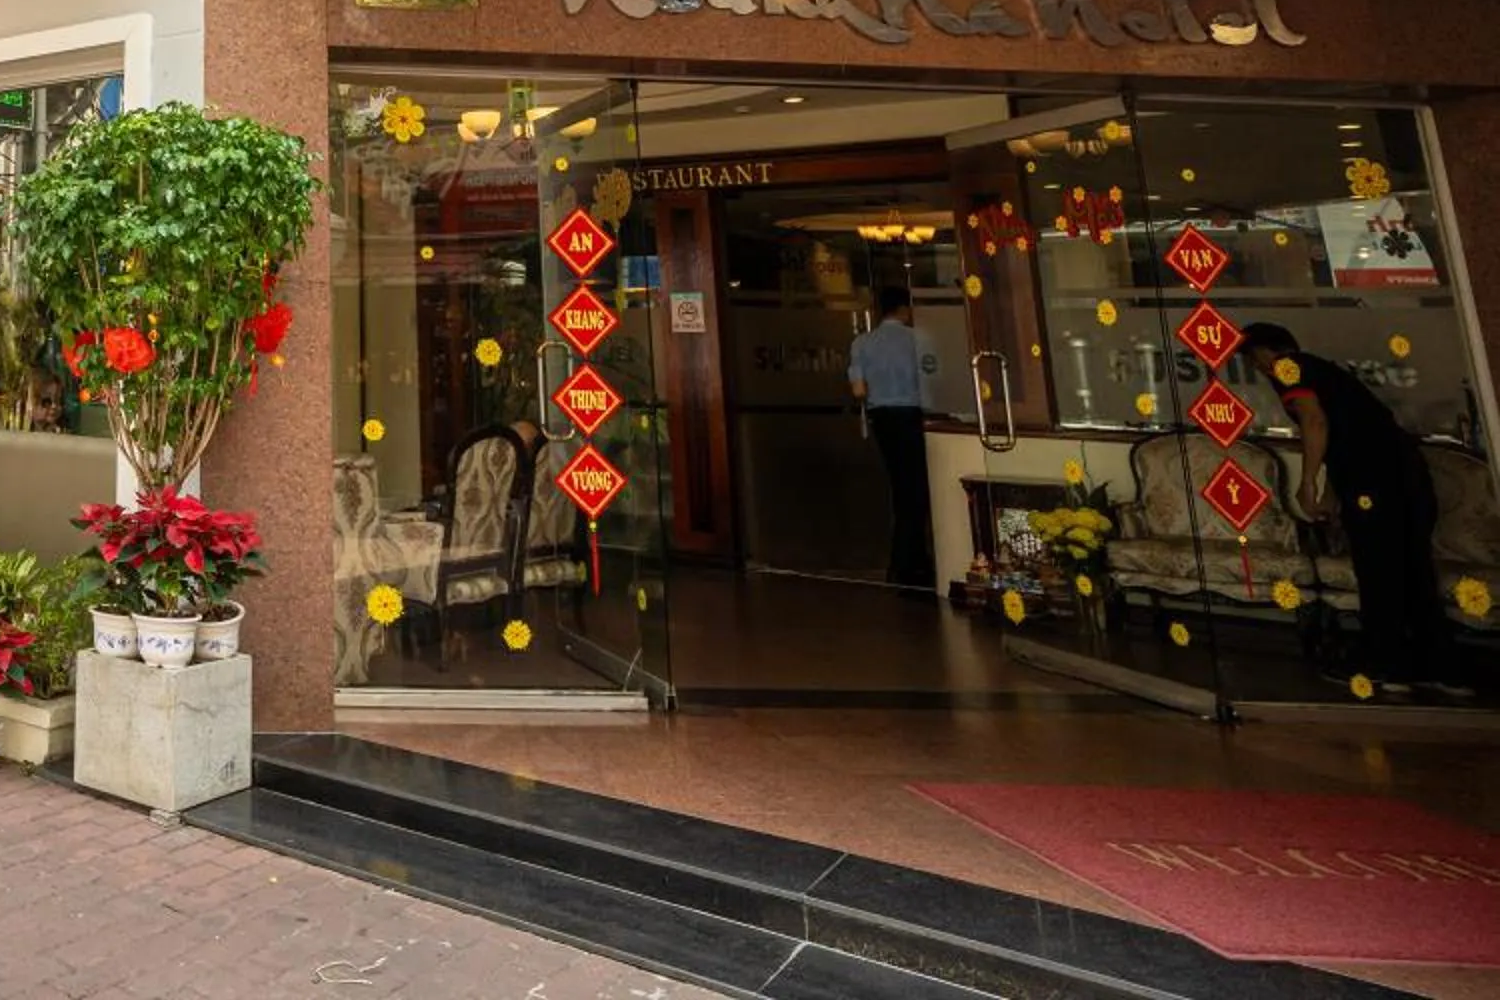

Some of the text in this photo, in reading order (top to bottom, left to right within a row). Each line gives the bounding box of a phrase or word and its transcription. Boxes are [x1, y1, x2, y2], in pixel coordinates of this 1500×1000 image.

[565, 232, 612, 495] AN KHANG THỊNH VƯỢNG
[1180, 249, 1240, 505] VẠN SỰ NHƯ Ý
